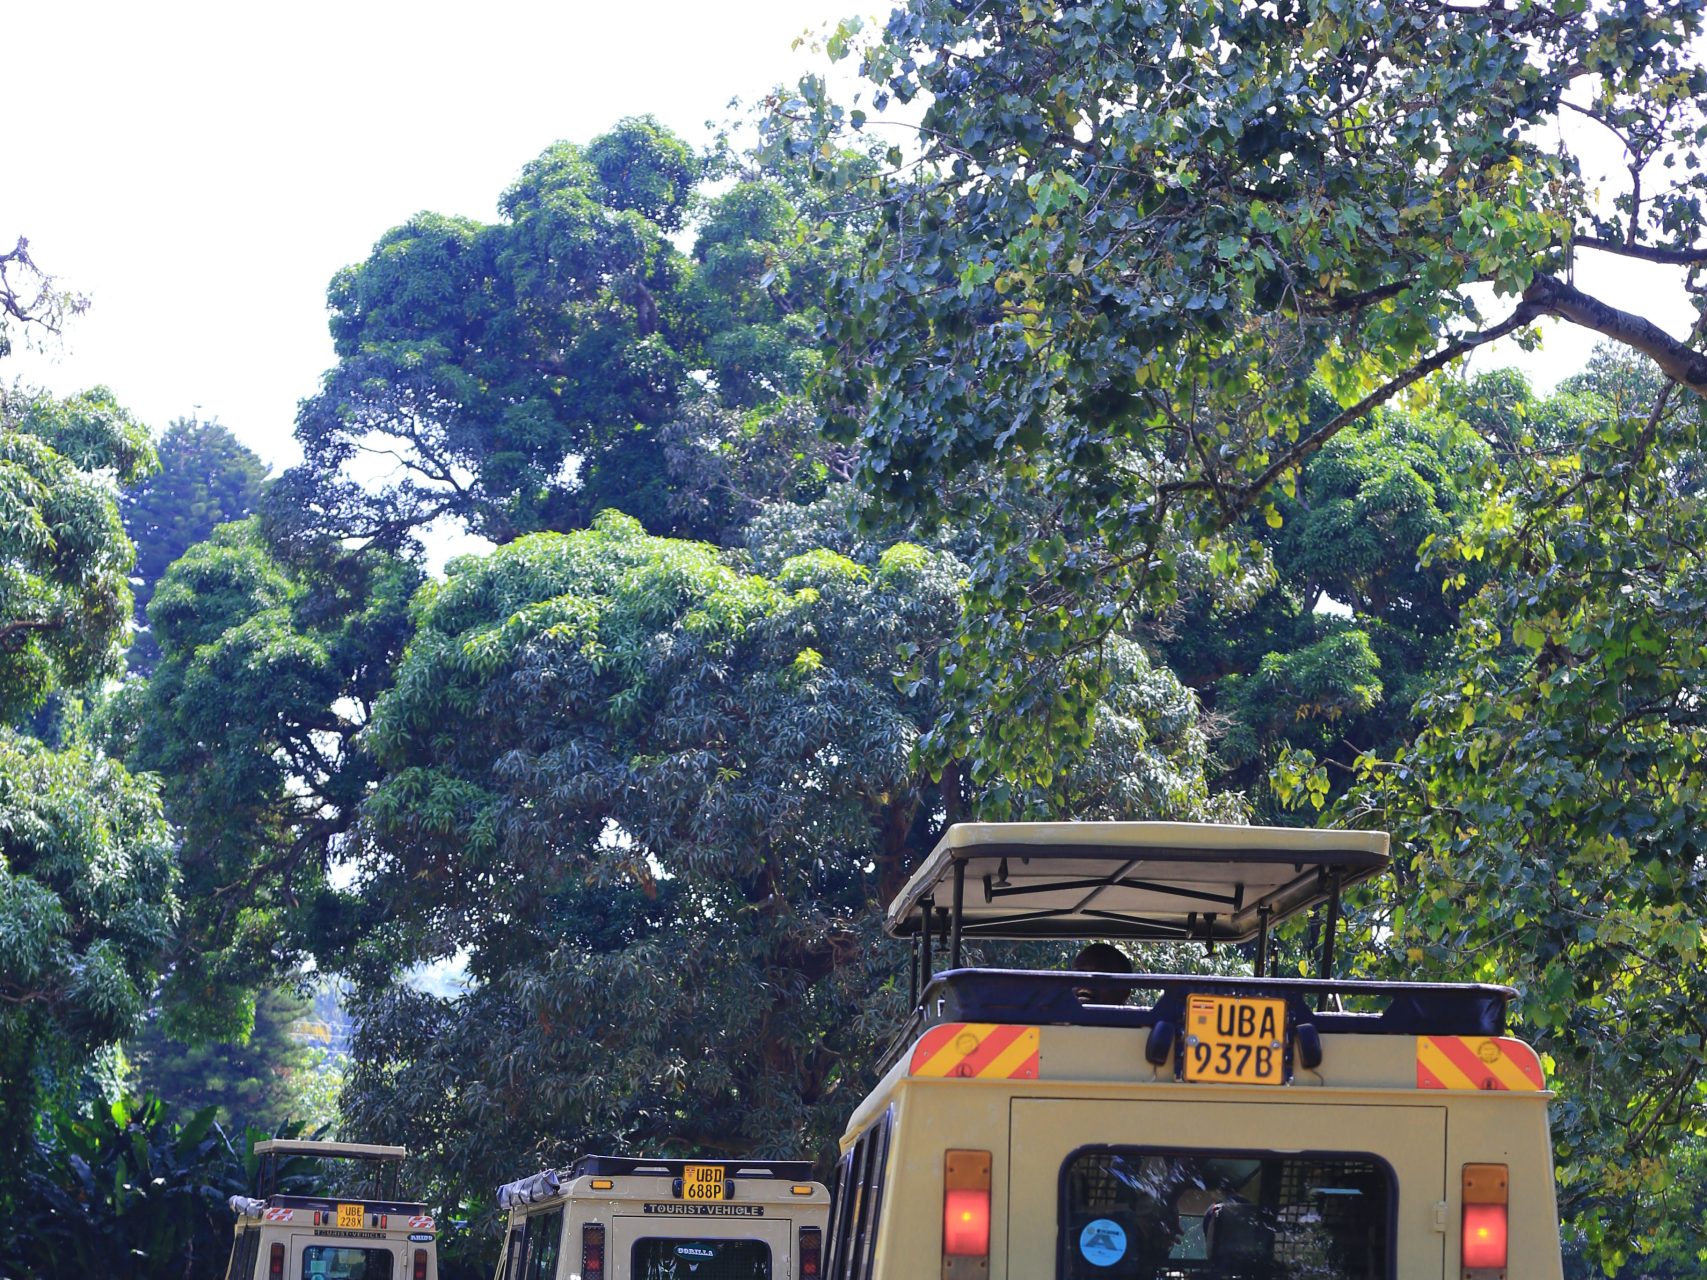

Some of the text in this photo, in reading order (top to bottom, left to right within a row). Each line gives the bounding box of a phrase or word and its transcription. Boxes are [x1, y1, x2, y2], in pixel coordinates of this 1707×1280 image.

[1217, 1004, 1275, 1039] UBA
[1194, 1042, 1273, 1078] 937B
[696, 1168, 722, 1182] UBD
[688, 1184, 722, 1198] 688P
[345, 1207, 362, 1217] UBE
[649, 1204, 759, 1216] TOURIST VEHICLE
